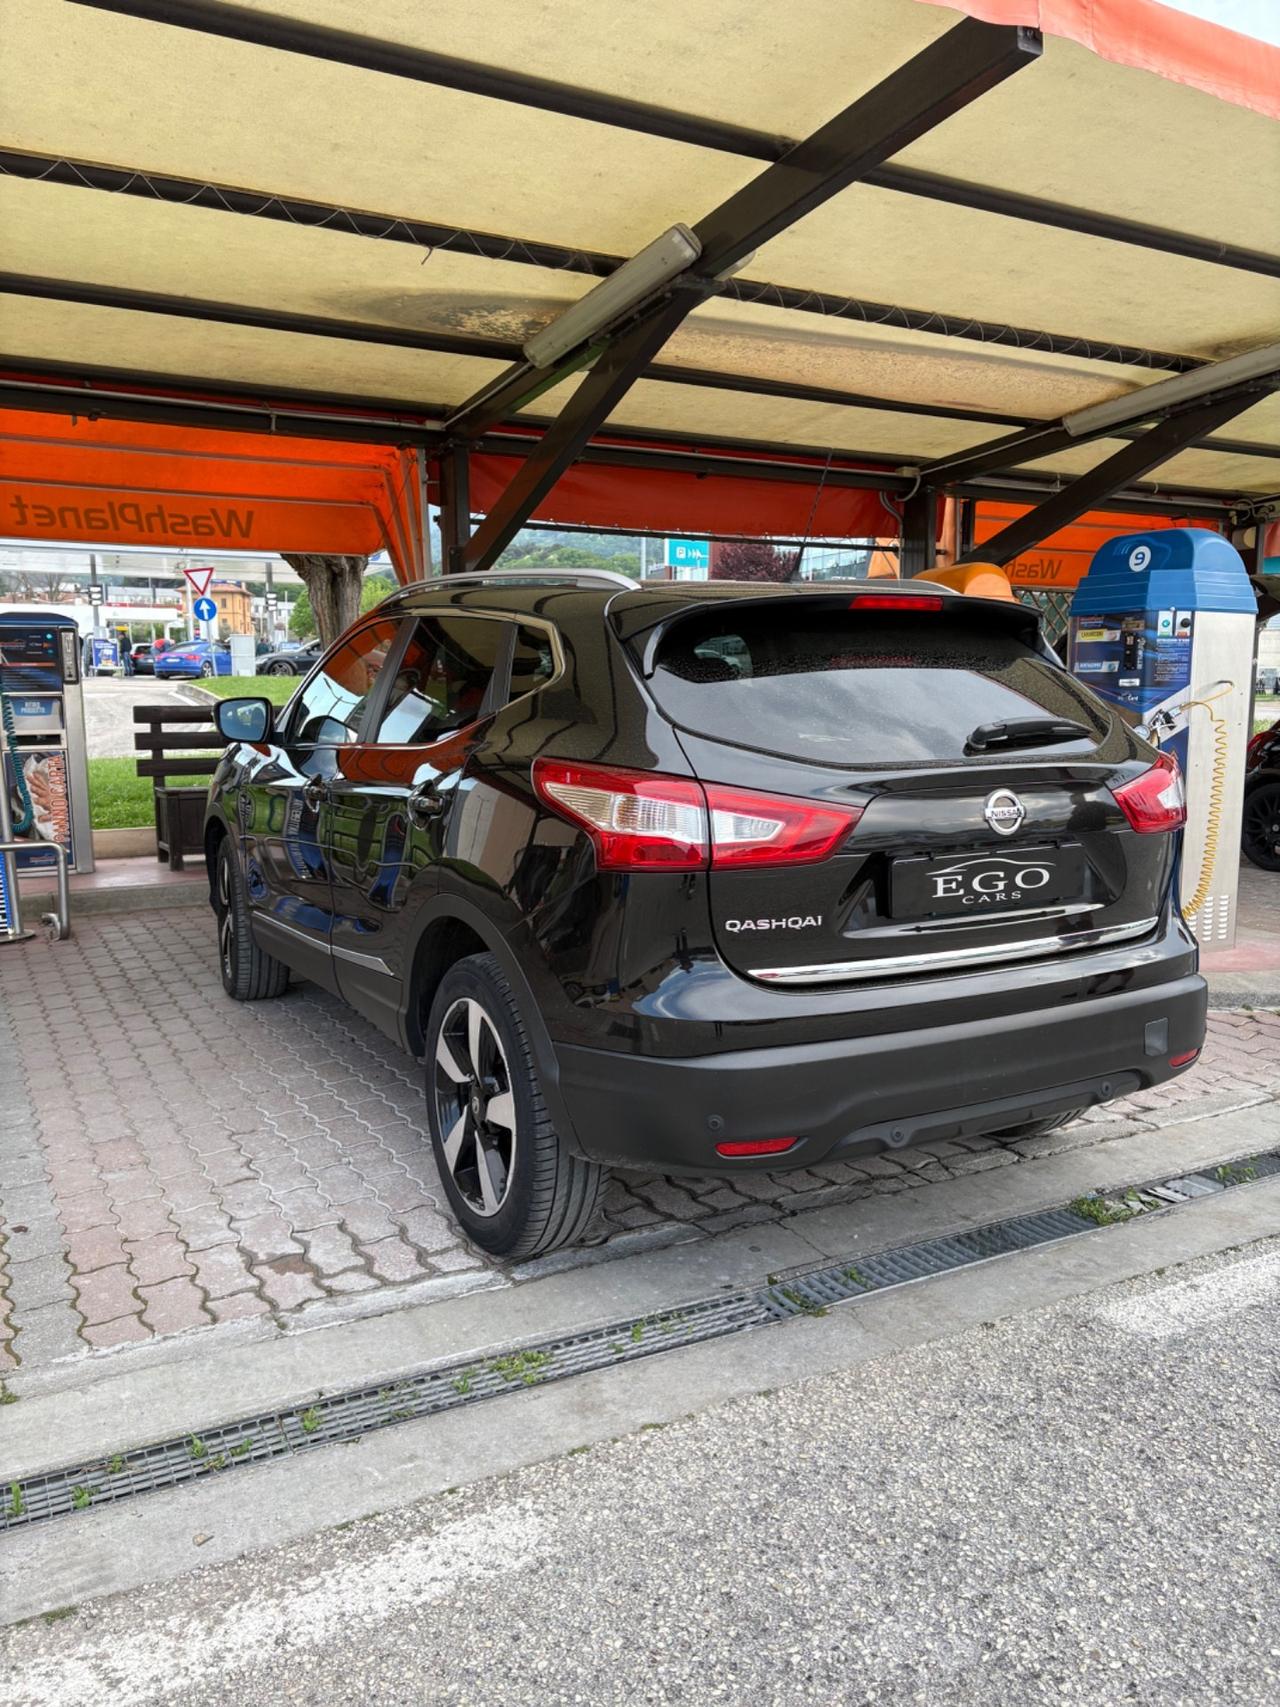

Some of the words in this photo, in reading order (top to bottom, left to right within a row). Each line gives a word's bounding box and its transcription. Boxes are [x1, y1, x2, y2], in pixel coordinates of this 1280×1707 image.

[1133, 551, 1145, 566] 9
[931, 867, 1050, 898] EGO
[962, 890, 1022, 904] CARS
[725, 915, 822, 933] QASHQAI
